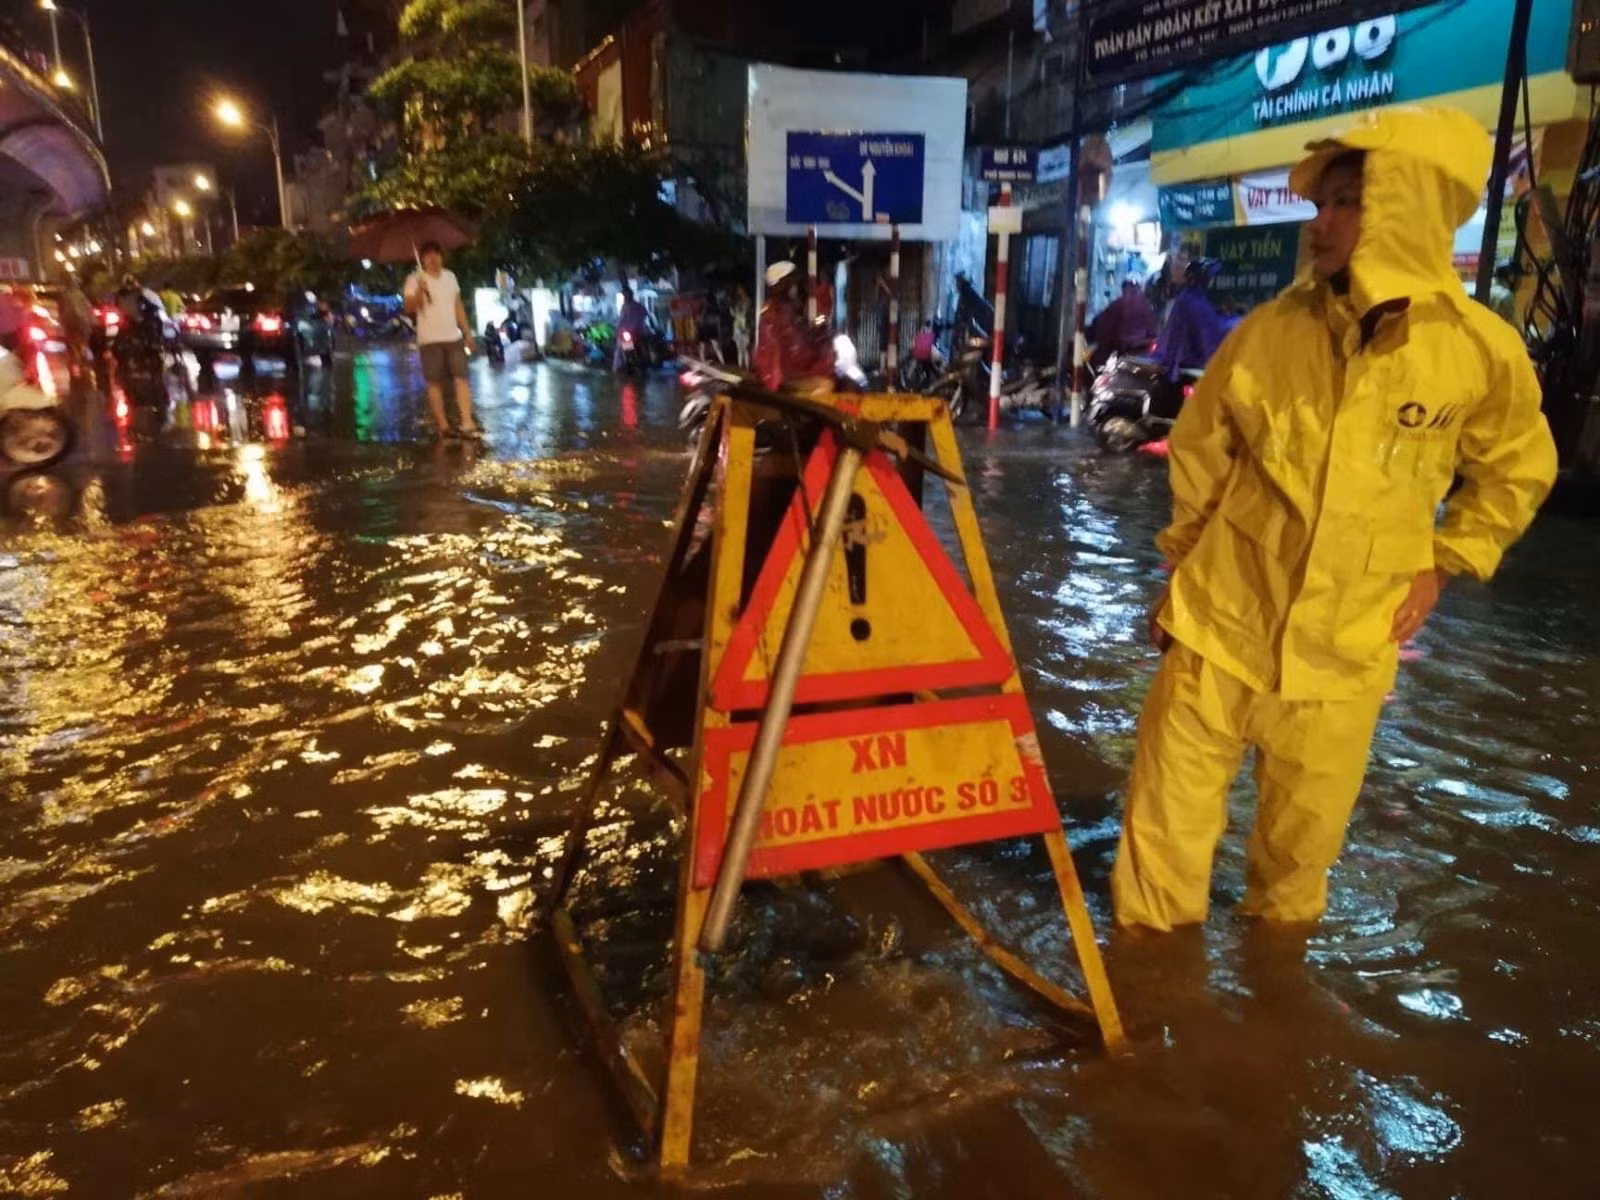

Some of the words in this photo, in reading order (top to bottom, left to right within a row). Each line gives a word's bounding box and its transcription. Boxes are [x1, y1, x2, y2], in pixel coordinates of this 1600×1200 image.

[1252, 96, 1274, 121] TÀI
[1275, 87, 1319, 117] CHÍNH
[1321, 77, 1342, 107] CÁ
[1346, 70, 1394, 104] NHÂN
[1248, 187, 1271, 208] VAY
[1220, 241, 1247, 261] VAY
[850, 732, 908, 774] XN
[852, 776, 947, 826] NƯỚC
[956, 764, 999, 811] SỐ
[1009, 775, 1029, 804] 3
